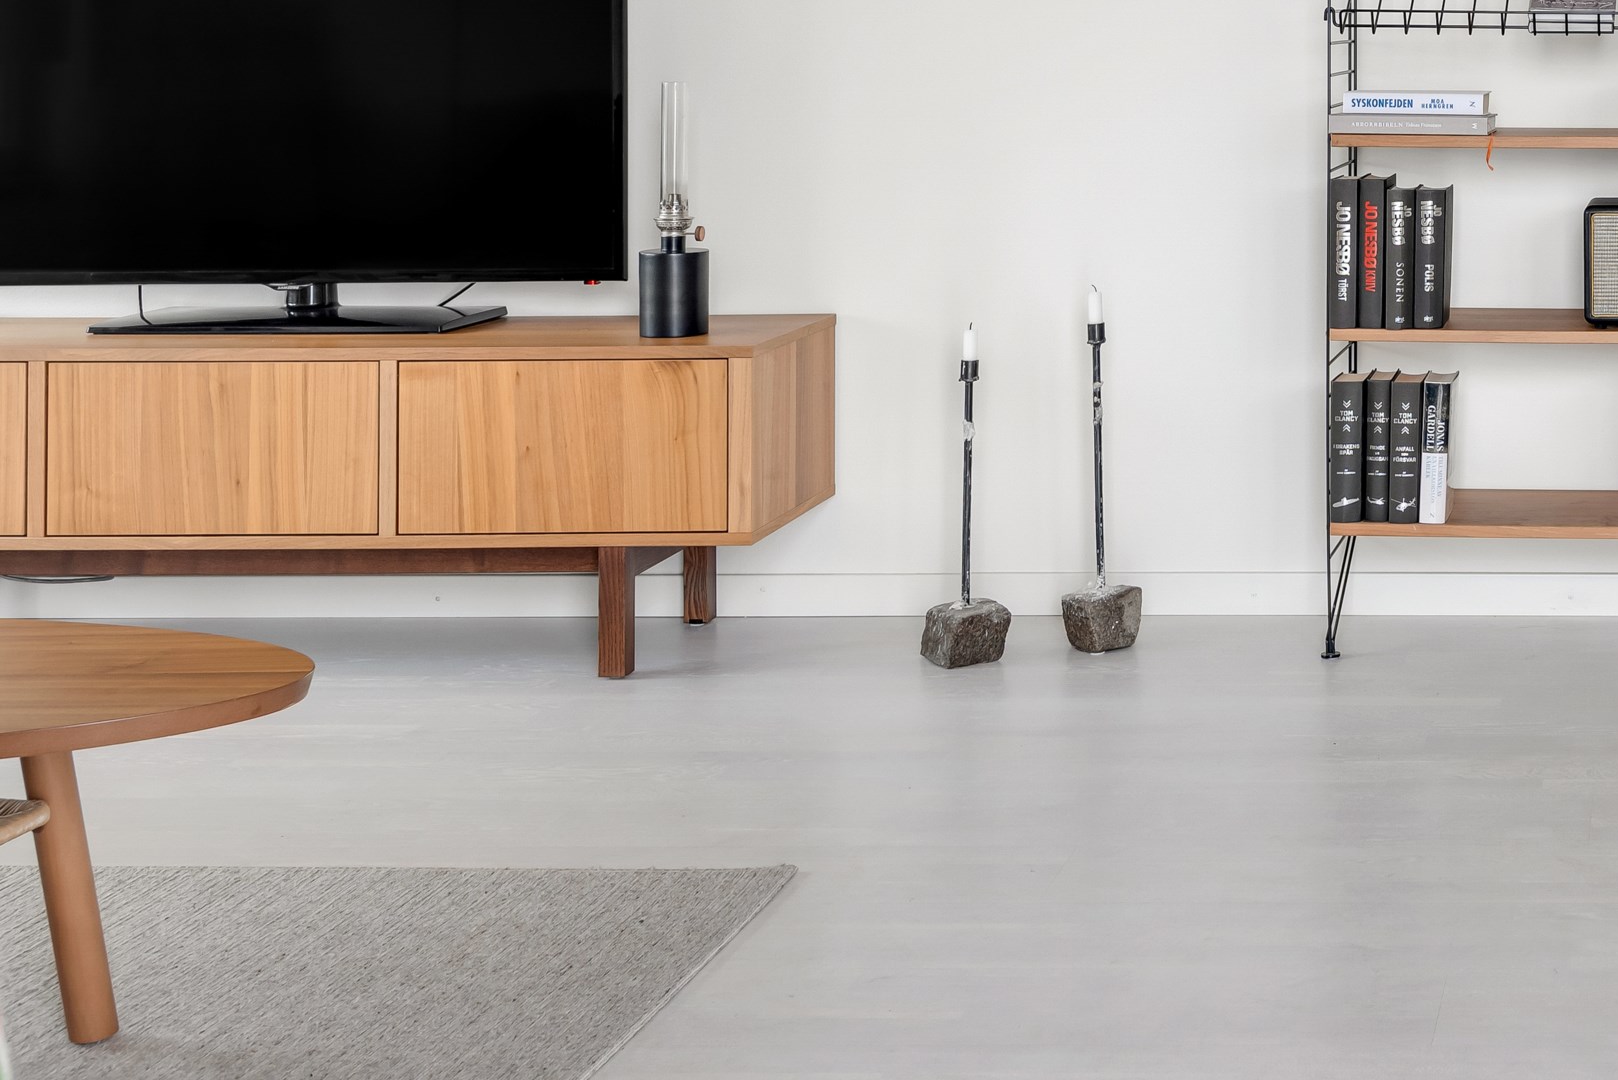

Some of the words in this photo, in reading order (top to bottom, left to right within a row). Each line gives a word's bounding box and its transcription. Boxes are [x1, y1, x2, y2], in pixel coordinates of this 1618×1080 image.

[1351, 98, 1414, 108] SYSKONFEJDEN
[1335, 201, 1352, 222] JO
[1364, 201, 1378, 221] JO
[1391, 201, 1406, 246] NESBØ
[1404, 206, 1412, 217] JO
[1420, 200, 1435, 245] NESBØ
[1433, 205, 1442, 217] JO
[1335, 223, 1351, 276] NESBØ
[1363, 222, 1377, 269] NESBØ
[1337, 278, 1348, 302] TÖRST
[1364, 270, 1376, 292] KNIV
[1395, 262, 1405, 303] SONEN
[1424, 264, 1434, 292] POLIS
[1426, 405, 1437, 452] GARDELL
[1436, 418, 1445, 452] JONAS
